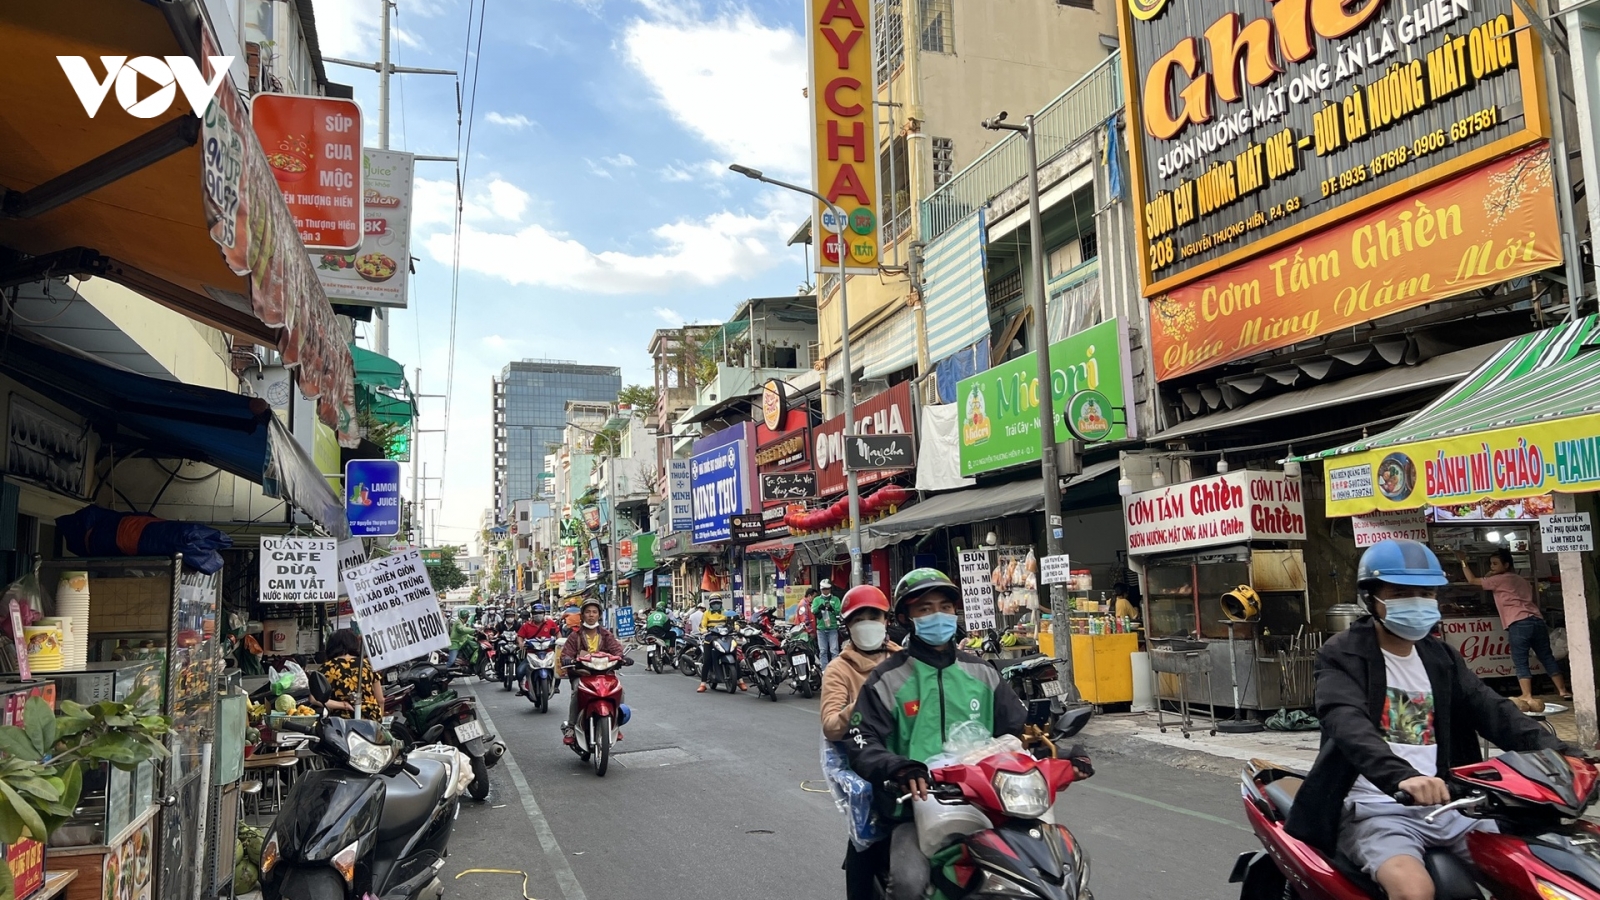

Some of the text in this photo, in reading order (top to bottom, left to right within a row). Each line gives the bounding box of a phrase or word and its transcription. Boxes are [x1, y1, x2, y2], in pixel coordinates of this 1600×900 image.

[1289, 62, 1330, 104] ONG
[1335, 43, 1364, 82] ĂN
[1366, 17, 1396, 65] LÀ
[1265, 127, 1295, 180] ONG
[1313, 100, 1341, 157] ĐÙI
[1343, 84, 1367, 143] GÀ
[1468, 14, 1513, 80] ONG
[325, 112, 353, 133] SÚP
[325, 143, 353, 161] CUA
[320, 167, 353, 191] MỘC
[1149, 236, 1174, 272] 208
[1285, 196, 1300, 213] Q3
[1339, 163, 1367, 190] 0935
[1450, 104, 1498, 142] 687581
[314, 233, 321, 241] 3
[1202, 198, 1464, 323] Cơm Tấm Ghiền
[1162, 230, 1539, 371] Chúc Mừng Năm Mới
[1005, 423, 1020, 437] Trái
[1020, 420, 1030, 436] Cây
[1424, 450, 1469, 497] BÁNH
[1470, 442, 1491, 491] MÌ
[1493, 437, 1542, 490] CHẢO
[371, 482, 397, 492] LAMON
[1250, 476, 1273, 502] CƠM
[376, 496, 397, 507] JUICE
[671, 491, 691, 501] MINH
[692, 482, 717, 520] MINH
[1127, 476, 1244, 527] CƠM TẤM Ghiền
[1251, 503, 1304, 535] Ghiền
[1562, 512, 1584, 523] TUYỂN
[1181, 524, 1196, 542] ONG
[1209, 519, 1219, 538] LÀ
[1220, 515, 1245, 536] Ghiền
[1355, 533, 1371, 545] ĐT:
[1409, 528, 1427, 540] 778
[1541, 526, 1546, 534] 2
[262, 538, 335, 551] QUÁN 215
[1550, 535, 1562, 544] LÀM
[1562, 535, 1576, 543] THEO
[271, 551, 321, 562] CAFE
[963, 552, 986, 562] BÚN
[276, 562, 318, 575] DỪA
[346, 560, 390, 581] QUÁN
[392, 550, 419, 566] 215
[960, 561, 990, 573] THỊT XÀO
[268, 579, 296, 590] CAM
[354, 579, 371, 593] BỘT
[397, 563, 416, 578] GIÒN
[961, 573, 991, 585] NUI MÌ
[262, 590, 336, 602] NƯỚC NGỌT CÁC LOẠI
[366, 589, 383, 603] XÀO
[397, 575, 425, 592] TRỨNG
[963, 585, 992, 597] XÀO BÒ
[356, 606, 372, 620] NUI
[372, 600, 389, 615] XÀO
[403, 586, 431, 603] TRỨNG
[969, 618, 993, 631] BÒ BÍA
[1442, 619, 1493, 634] CƠM TẤM
[364, 626, 388, 661] BỘT
[417, 608, 445, 641] GIÒN
